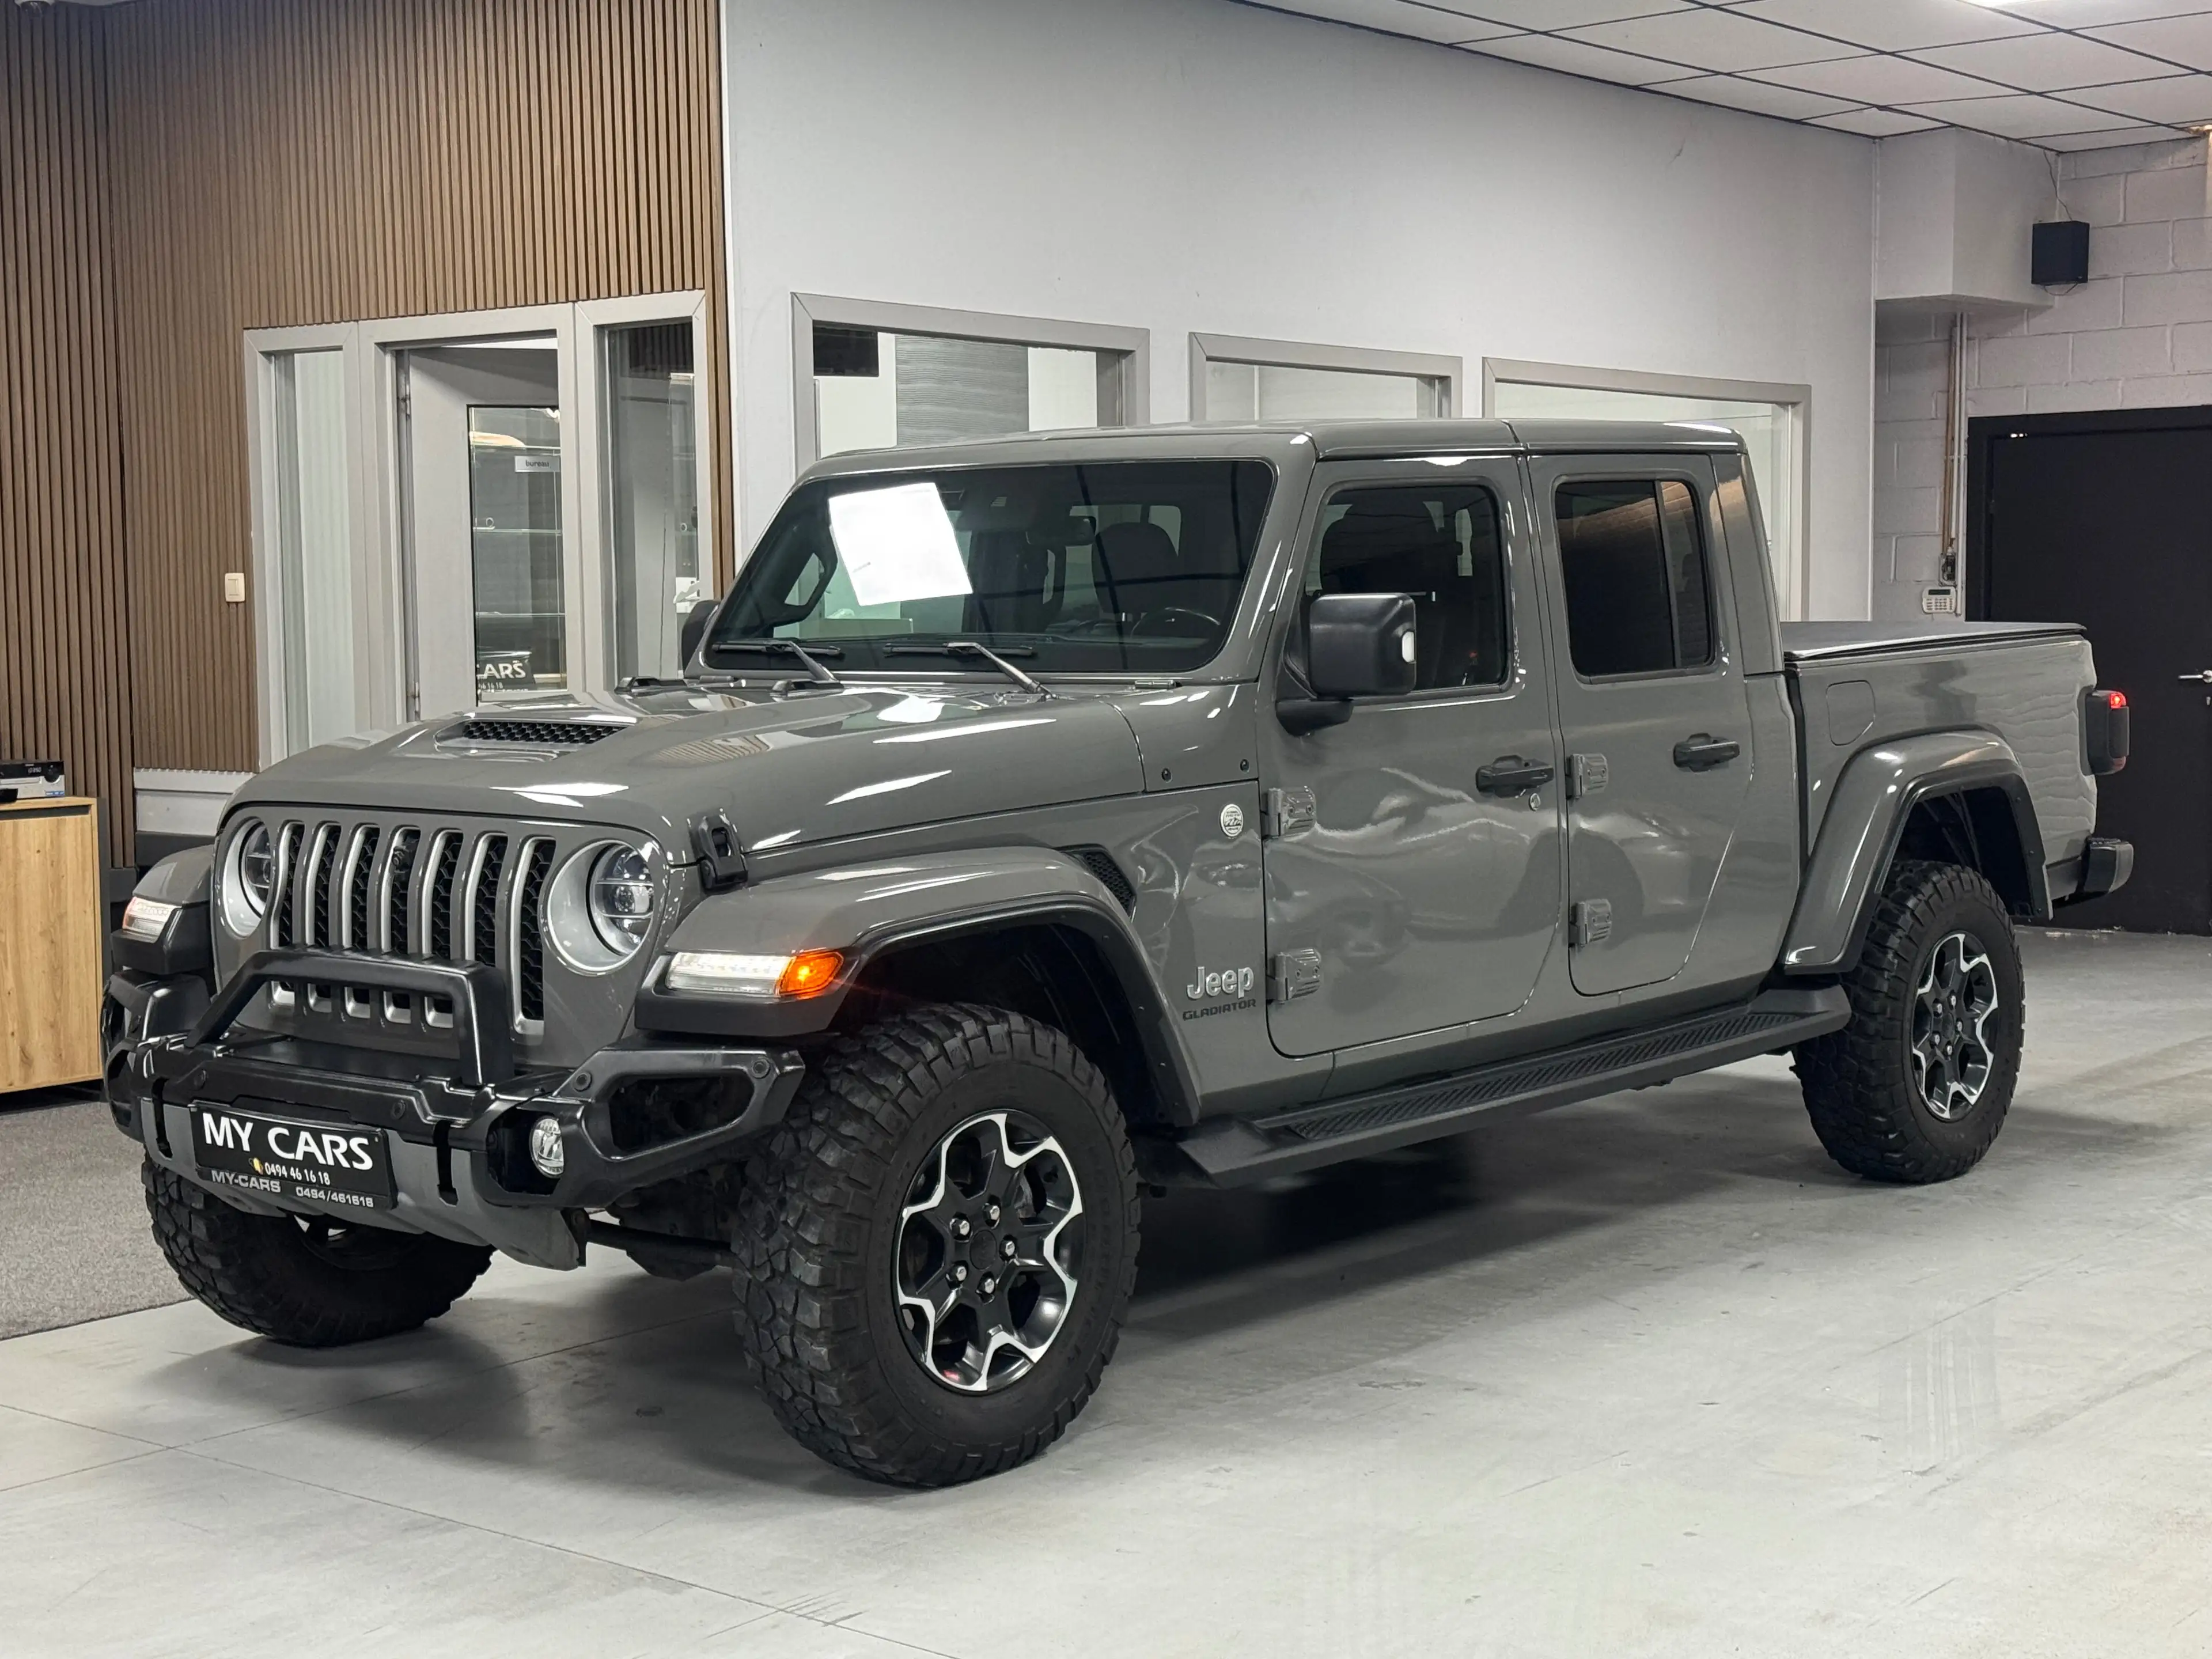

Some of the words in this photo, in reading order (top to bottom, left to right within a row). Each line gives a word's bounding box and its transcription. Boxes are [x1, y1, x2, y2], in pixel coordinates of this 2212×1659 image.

[525, 459, 550, 467] bureau
[1187, 966, 1255, 1001] Jeep
[1183, 998, 1257, 1021] GLADIATOR
[202, 1112, 254, 1152] MY
[267, 1127, 373, 1171] CARS
[264, 1162, 288, 1179] 0494
[290, 1166, 302, 1181] 46
[305, 1169, 316, 1183] 16
[319, 1171, 331, 1186] 18
[211, 1170, 281, 1193] MY-CARS
[296, 1187, 374, 1208] 0494/461618
